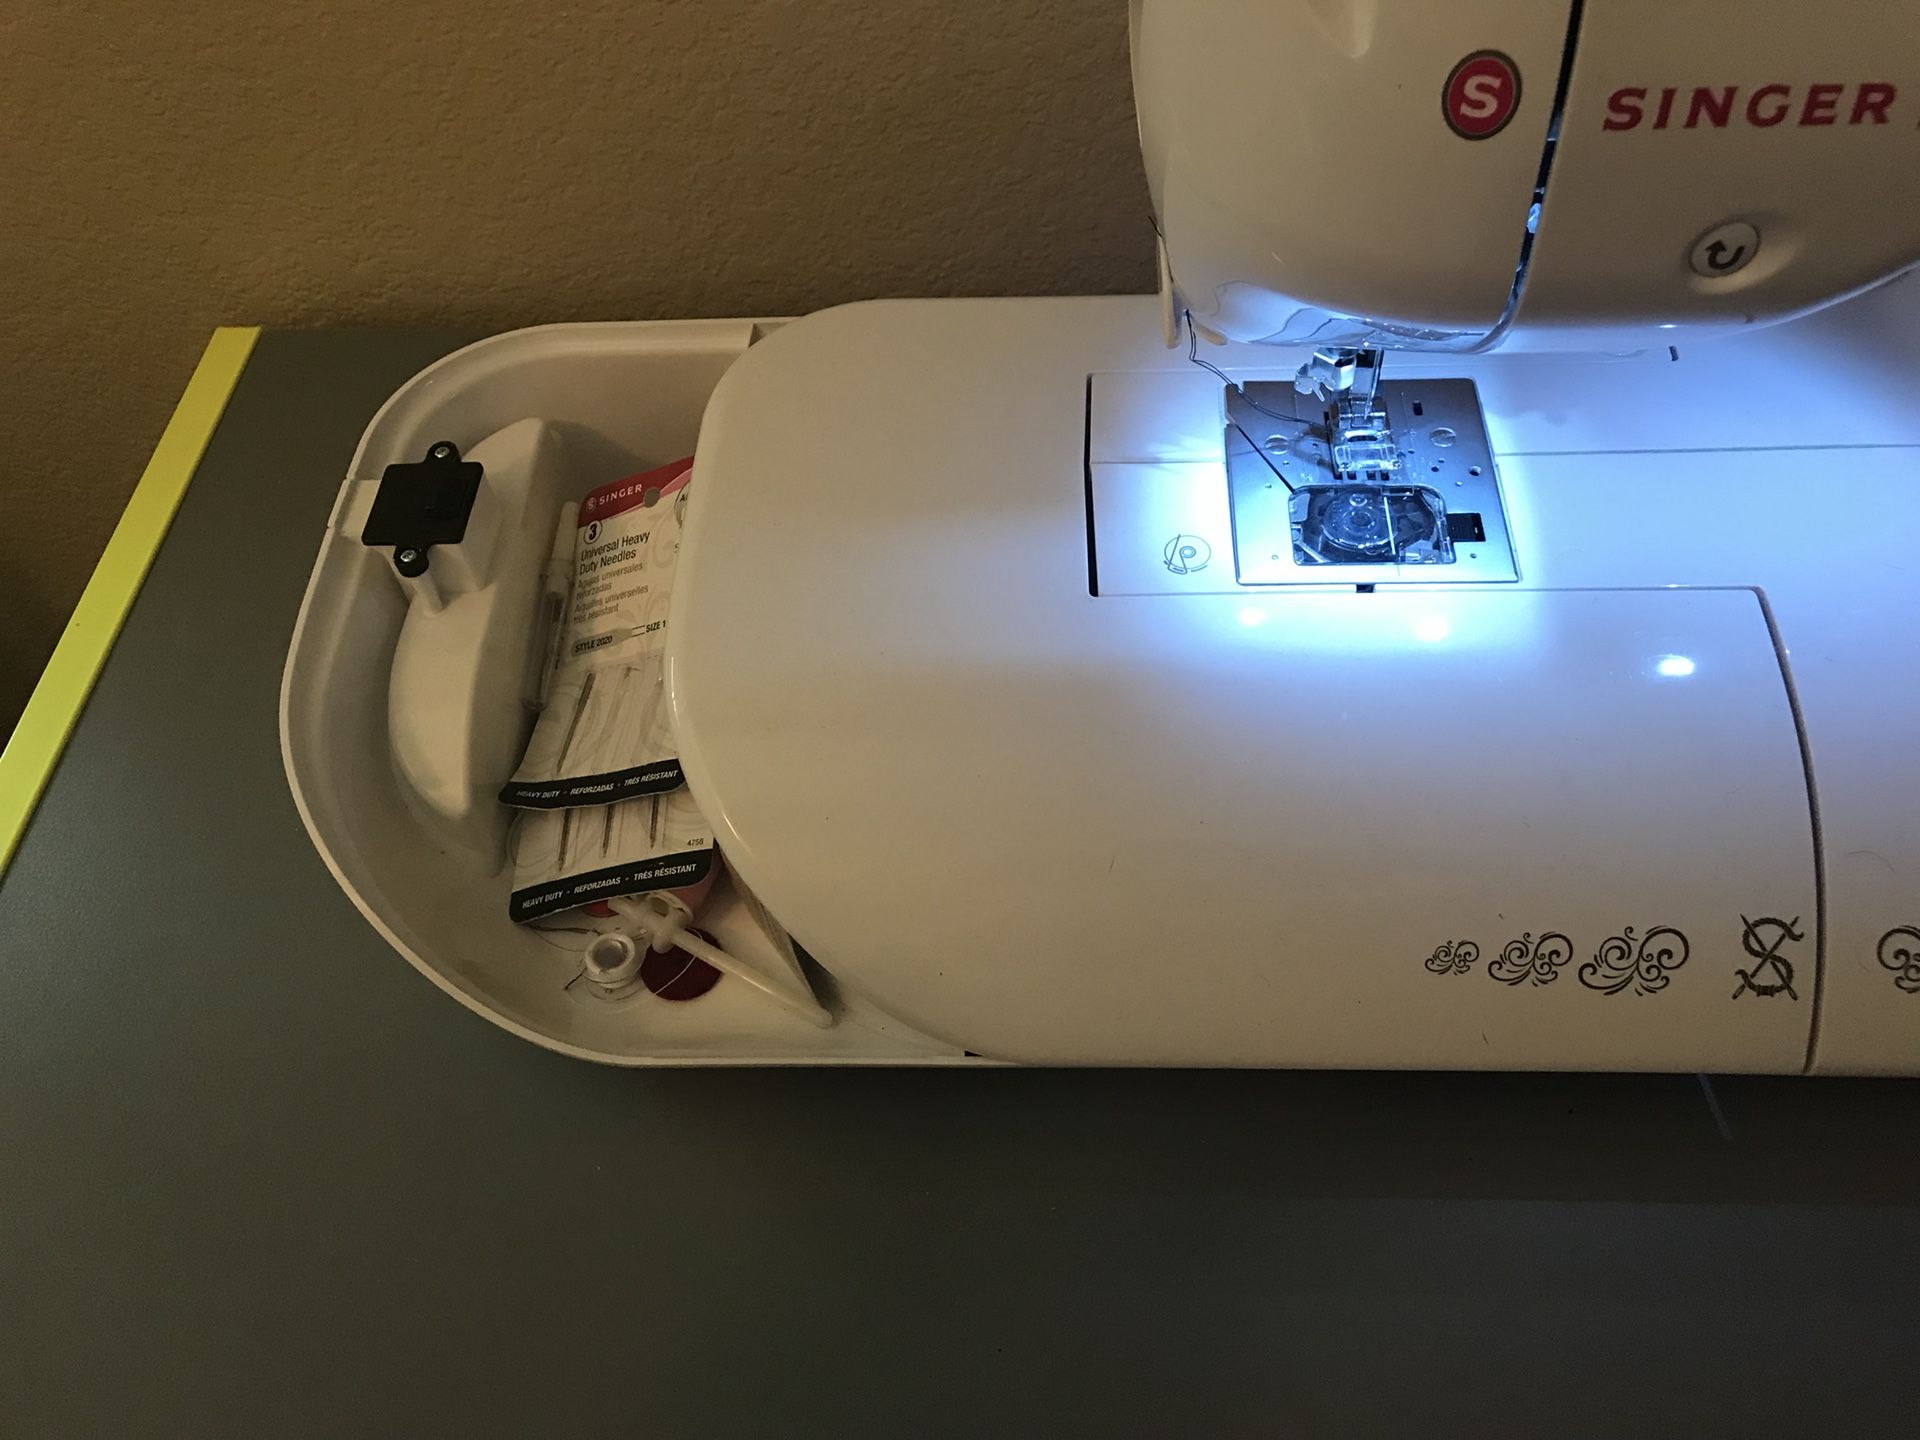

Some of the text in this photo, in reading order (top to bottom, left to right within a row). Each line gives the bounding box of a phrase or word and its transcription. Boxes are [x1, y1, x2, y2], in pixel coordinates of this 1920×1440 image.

[1459, 74, 1502, 118] S
[1602, 83, 1897, 132] SINGER
[599, 483, 642, 505] SINGER
[581, 538, 620, 561] Universal
[621, 531, 651, 548] Heavy
[589, 523, 598, 541] 3
[579, 549, 637, 576] Duty Needles
[646, 620, 661, 633] SIZE
[575, 635, 613, 653] STYLE 2020
[541, 790, 560, 798] DUTY
[570, 783, 614, 795] REFORZADAS
[640, 769, 678, 783] RÉSISTANT
[522, 896, 544, 909] HEAVY
[544, 890, 564, 902] DUTY
[573, 877, 621, 894] REFORZADAS
[654, 863, 697, 877] RÉSISTANT
